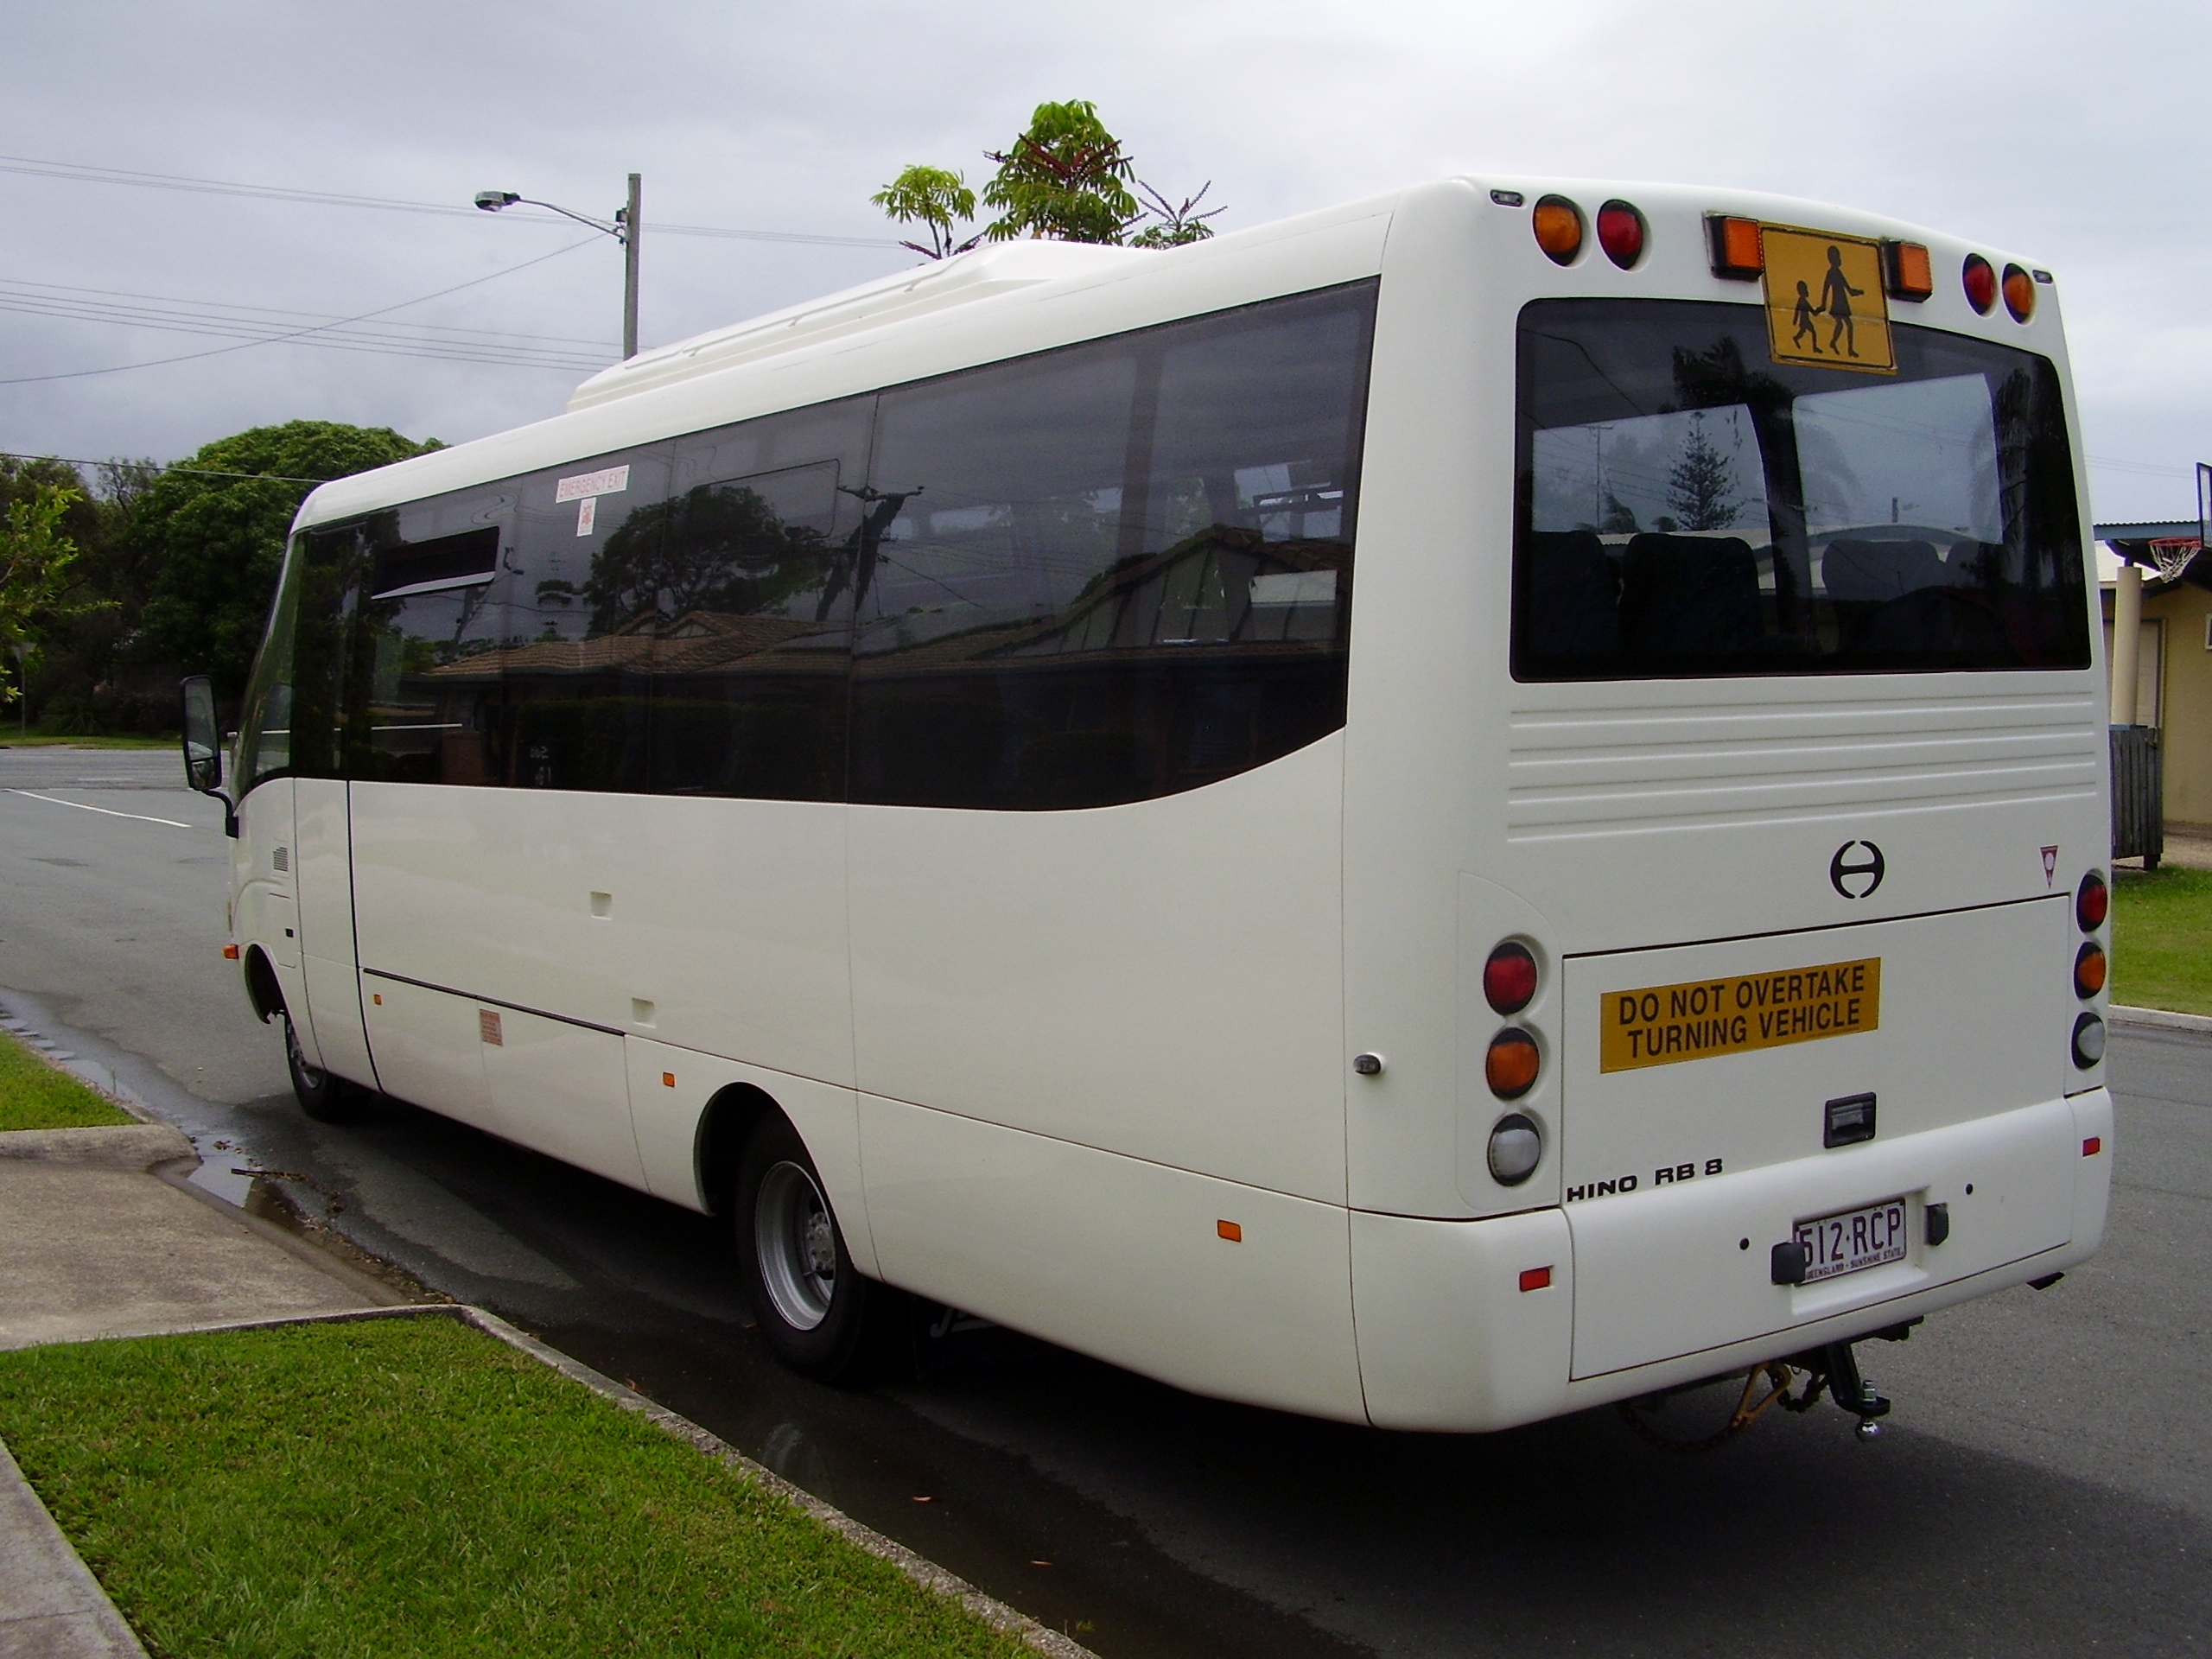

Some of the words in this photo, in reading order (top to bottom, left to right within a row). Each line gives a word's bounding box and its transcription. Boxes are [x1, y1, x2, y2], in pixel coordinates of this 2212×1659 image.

[559, 475, 607, 498] EMERGENCY
[608, 470, 626, 489] EXIT
[1619, 993, 1660, 1026] DO
[1671, 984, 1725, 1019] NOT
[1735, 964, 1865, 1009] OVERTAKE
[1628, 1014, 1747, 1058] TURNING
[1758, 998, 1860, 1039] VEHICLE
[1567, 1174, 1638, 1203] HINO
[1655, 1162, 1695, 1185] RB
[1705, 1158, 1723, 1176] 8
